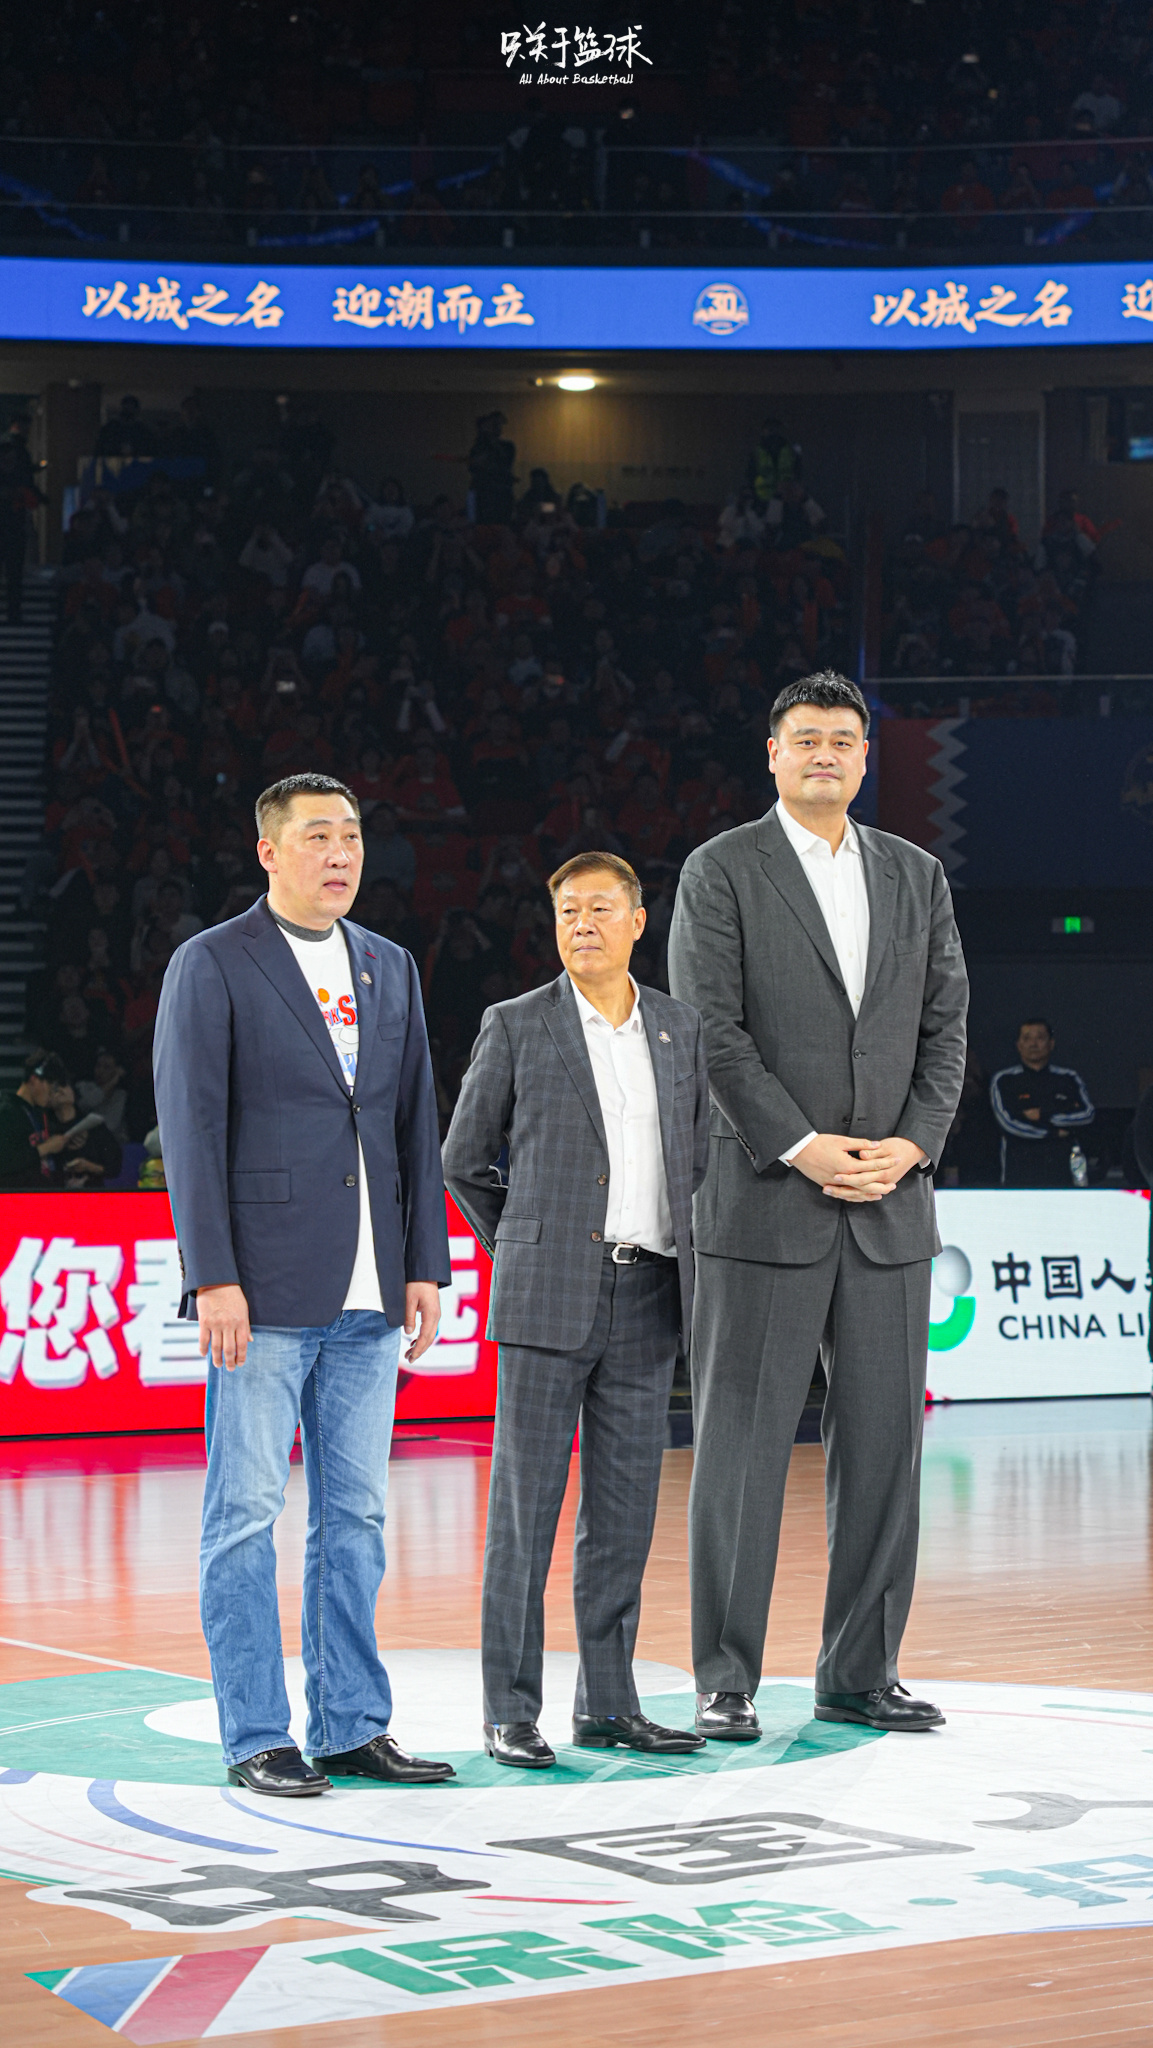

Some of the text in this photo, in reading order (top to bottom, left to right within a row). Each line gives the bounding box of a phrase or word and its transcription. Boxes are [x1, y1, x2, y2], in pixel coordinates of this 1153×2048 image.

[82, 277, 535, 334] 以城之名 迎潮而立
[706, 291, 738, 317] 30
[870, 279, 1073, 333] 以城之名
[991, 1252, 1153, 1304] 中国人
[998, 1314, 1106, 1340] CHINA
